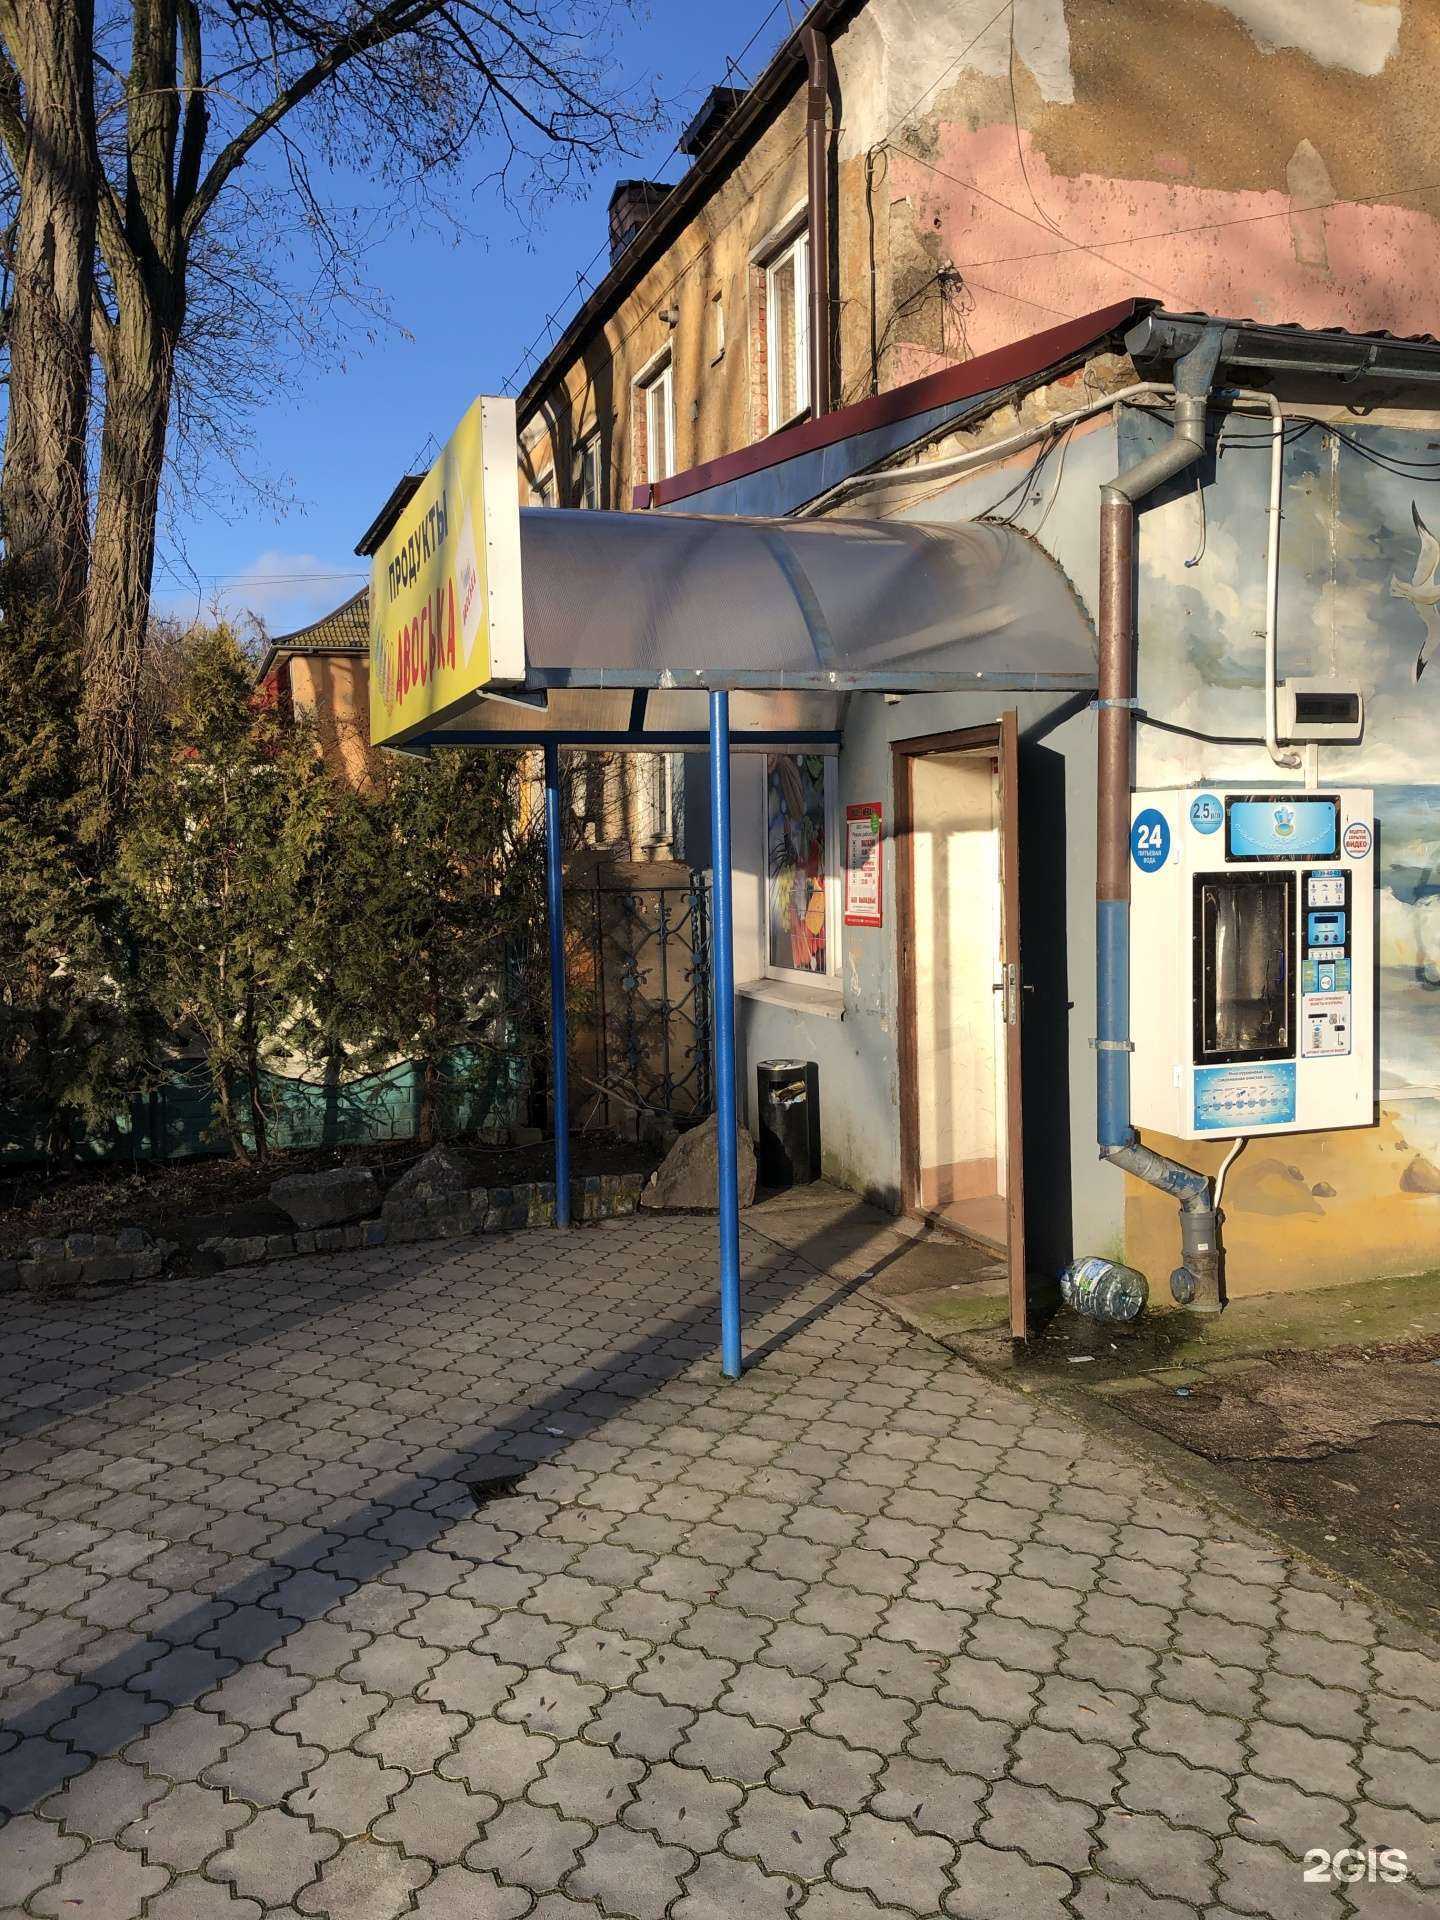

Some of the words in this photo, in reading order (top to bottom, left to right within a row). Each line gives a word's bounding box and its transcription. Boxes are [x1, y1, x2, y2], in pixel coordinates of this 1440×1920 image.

[388, 490, 448, 603] ПРОДУКТЫ
[396, 576, 456, 706] АВОСЬКА
[1137, 824, 1163, 849] 24
[1193, 803, 1210, 820] 2,5
